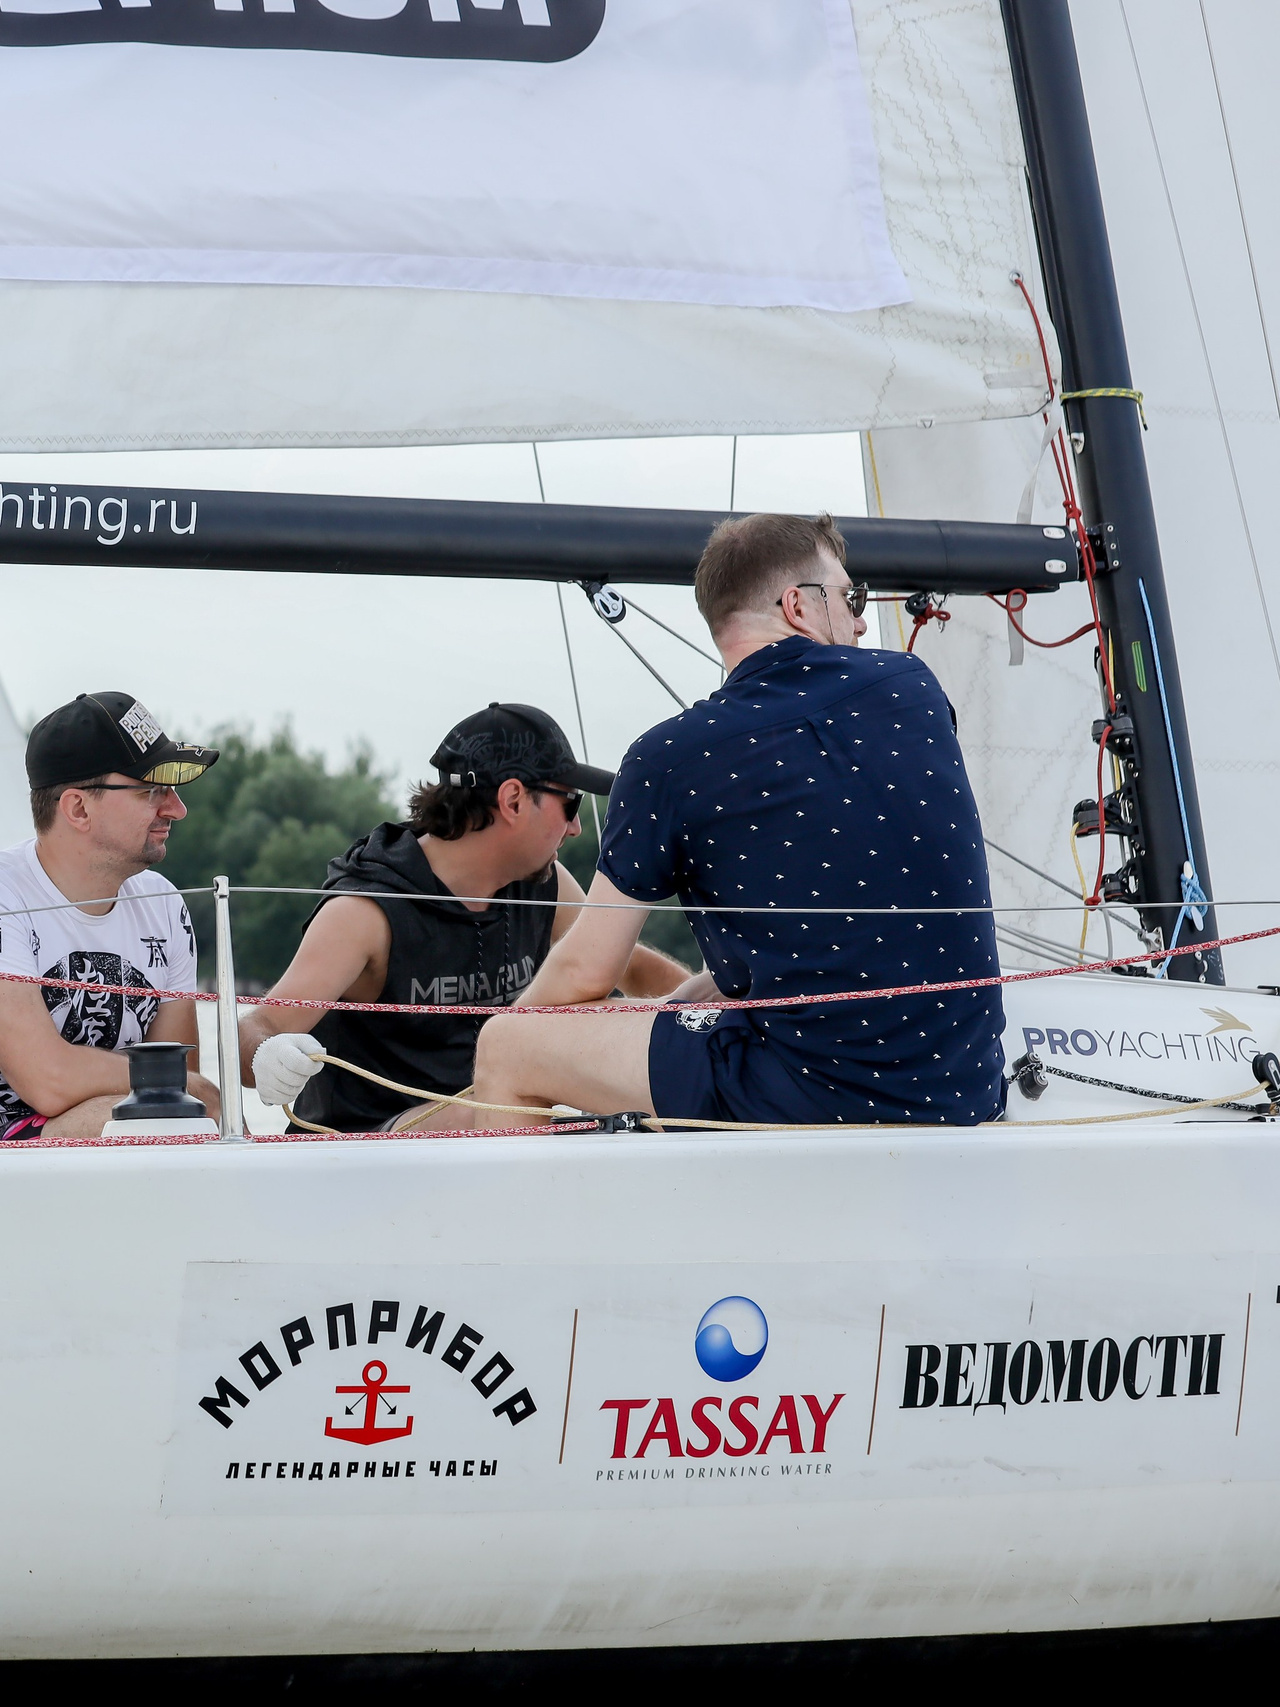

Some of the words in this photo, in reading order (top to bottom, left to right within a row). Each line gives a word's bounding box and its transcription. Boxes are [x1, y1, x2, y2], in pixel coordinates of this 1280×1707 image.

[1022, 1027, 1261, 1064] PROYACHTING
[198, 1300, 538, 1429] МОРПРИБОР
[898, 1333, 1226, 1417] ВЕДОМОСТИ
[598, 1392, 847, 1459] TASSAY
[225, 1461, 417, 1481] ЛЕГЕНДАРНЫЕ
[429, 1459, 499, 1477] ЧАСЫ
[595, 1468, 676, 1481] PREMIUM
[685, 1465, 771, 1479] DRINKING
[780, 1463, 833, 1476] WATER
